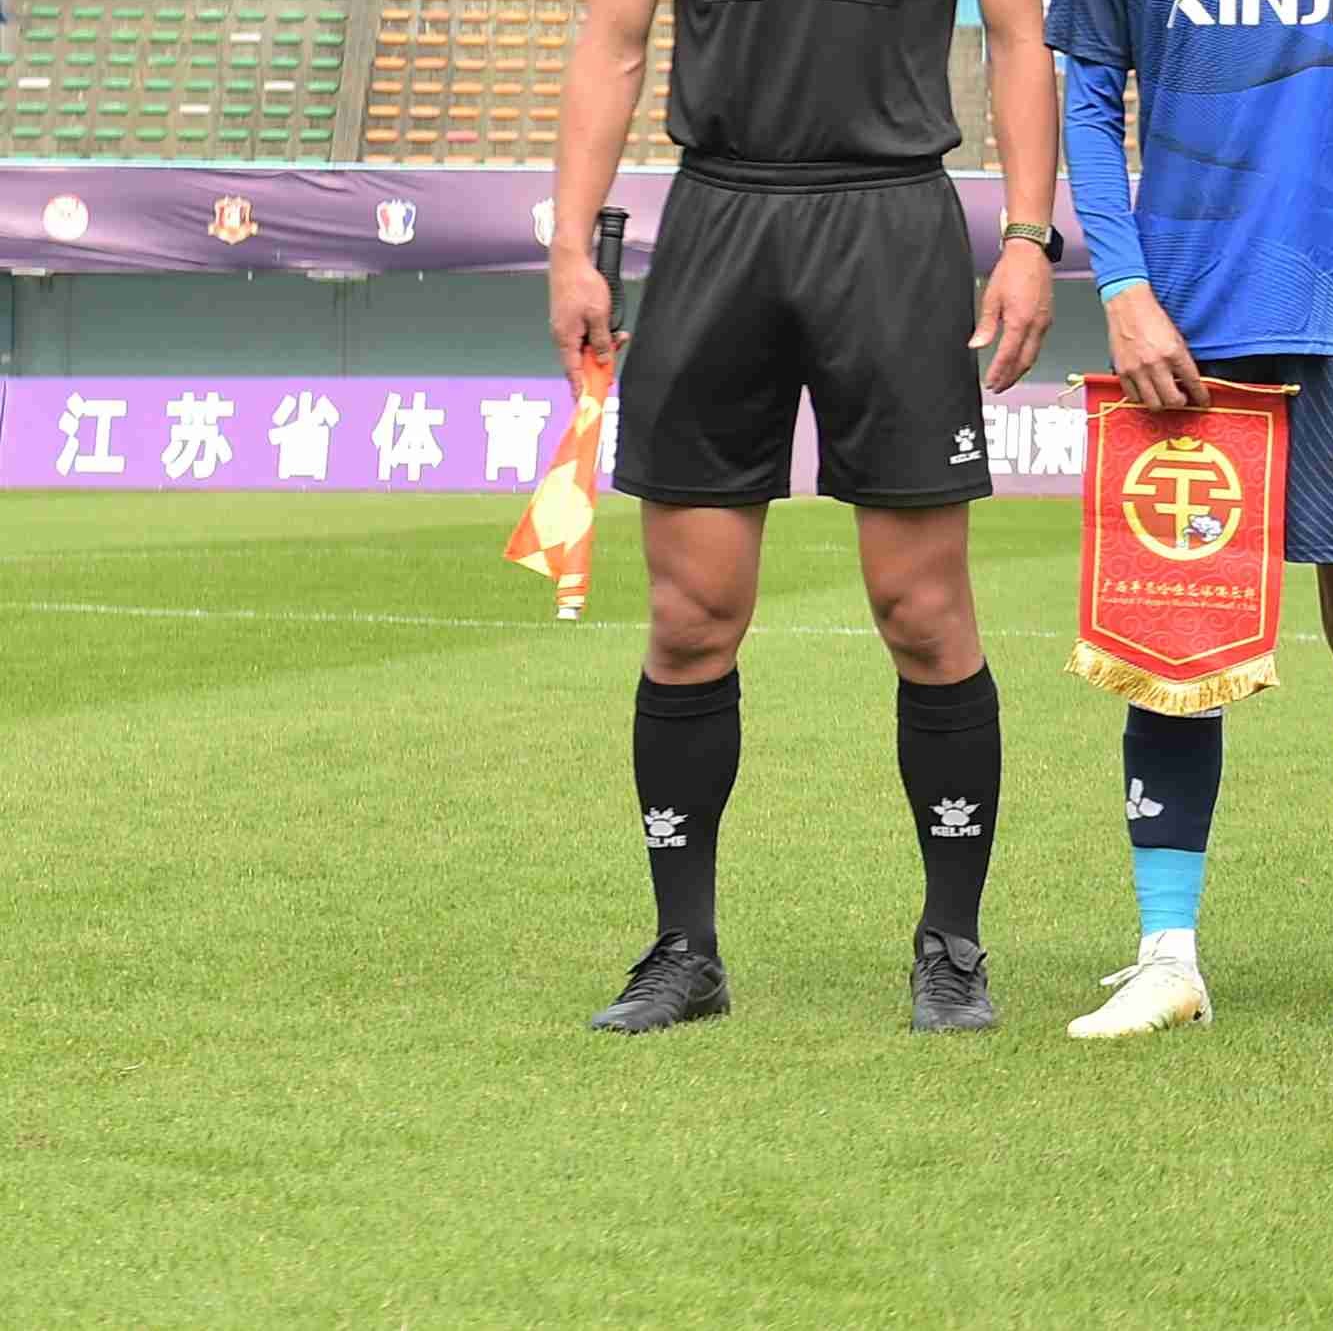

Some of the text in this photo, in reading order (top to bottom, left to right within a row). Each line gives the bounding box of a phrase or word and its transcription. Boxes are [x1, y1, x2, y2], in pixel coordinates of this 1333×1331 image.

[56, 391, 620, 481] 江苏省体育
[931, 825, 982, 837] KELME
[645, 835, 688, 848] ELME
